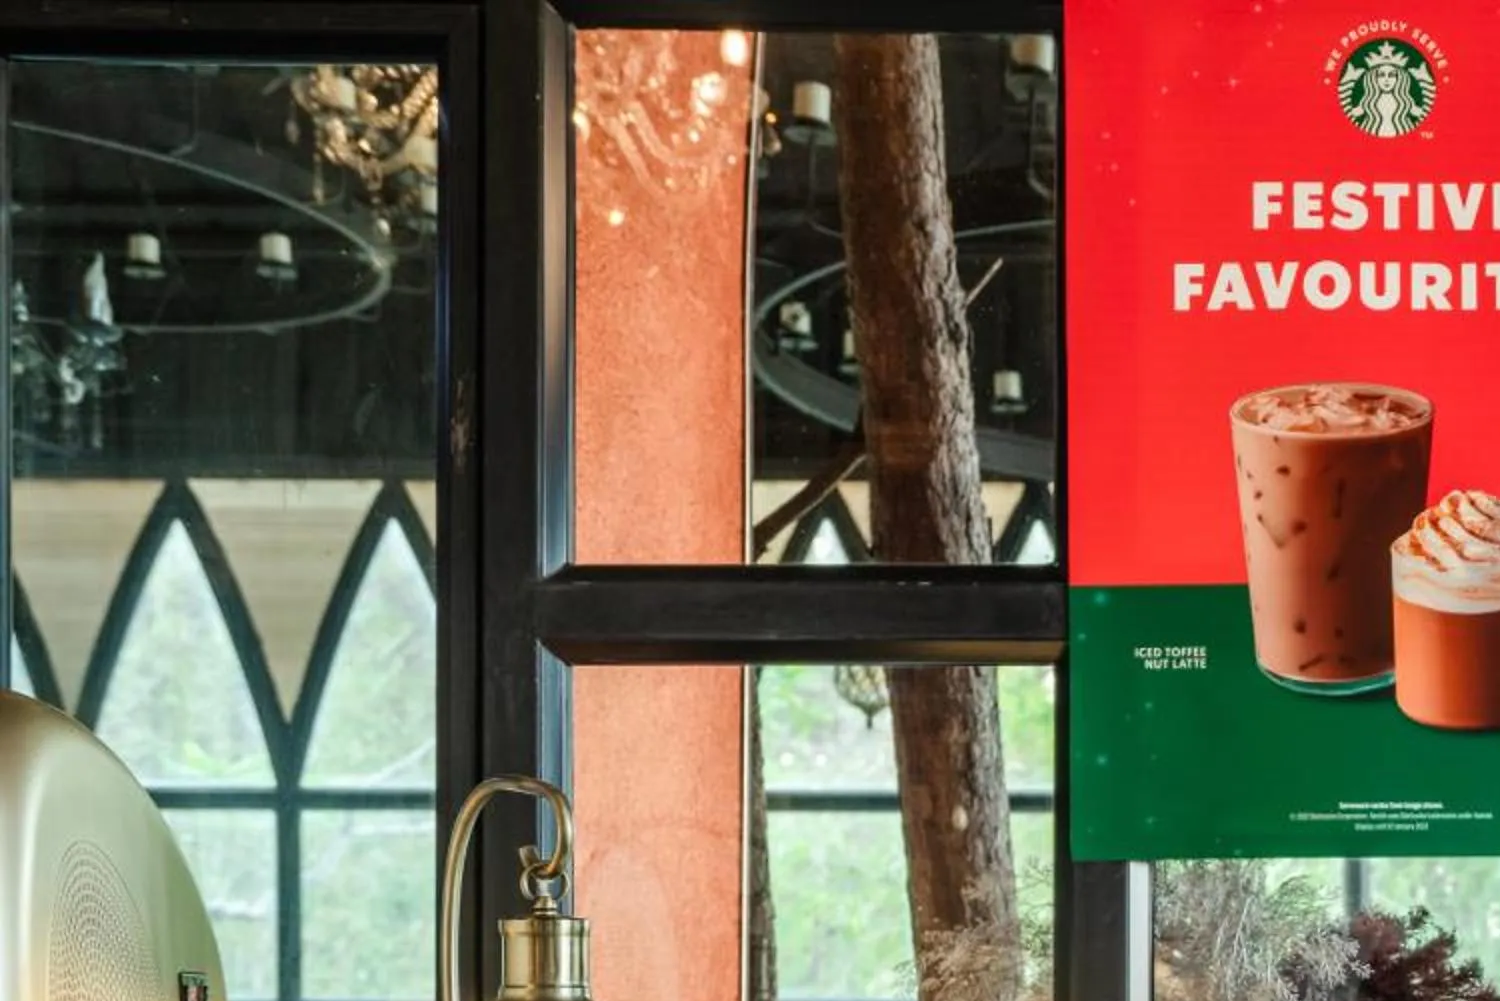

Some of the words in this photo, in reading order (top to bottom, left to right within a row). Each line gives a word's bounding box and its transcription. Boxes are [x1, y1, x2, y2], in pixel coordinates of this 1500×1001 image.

[1325, 48, 1342, 71] WE
[1340, 20, 1407, 48] PROUDLY
[1411, 28, 1448, 69] SERVE
[1134, 647, 1162, 657] ICED
[1165, 646, 1207, 657] TOFFEE
[1144, 659, 1168, 669] NUT
[1172, 658, 1207, 669] LATTE
